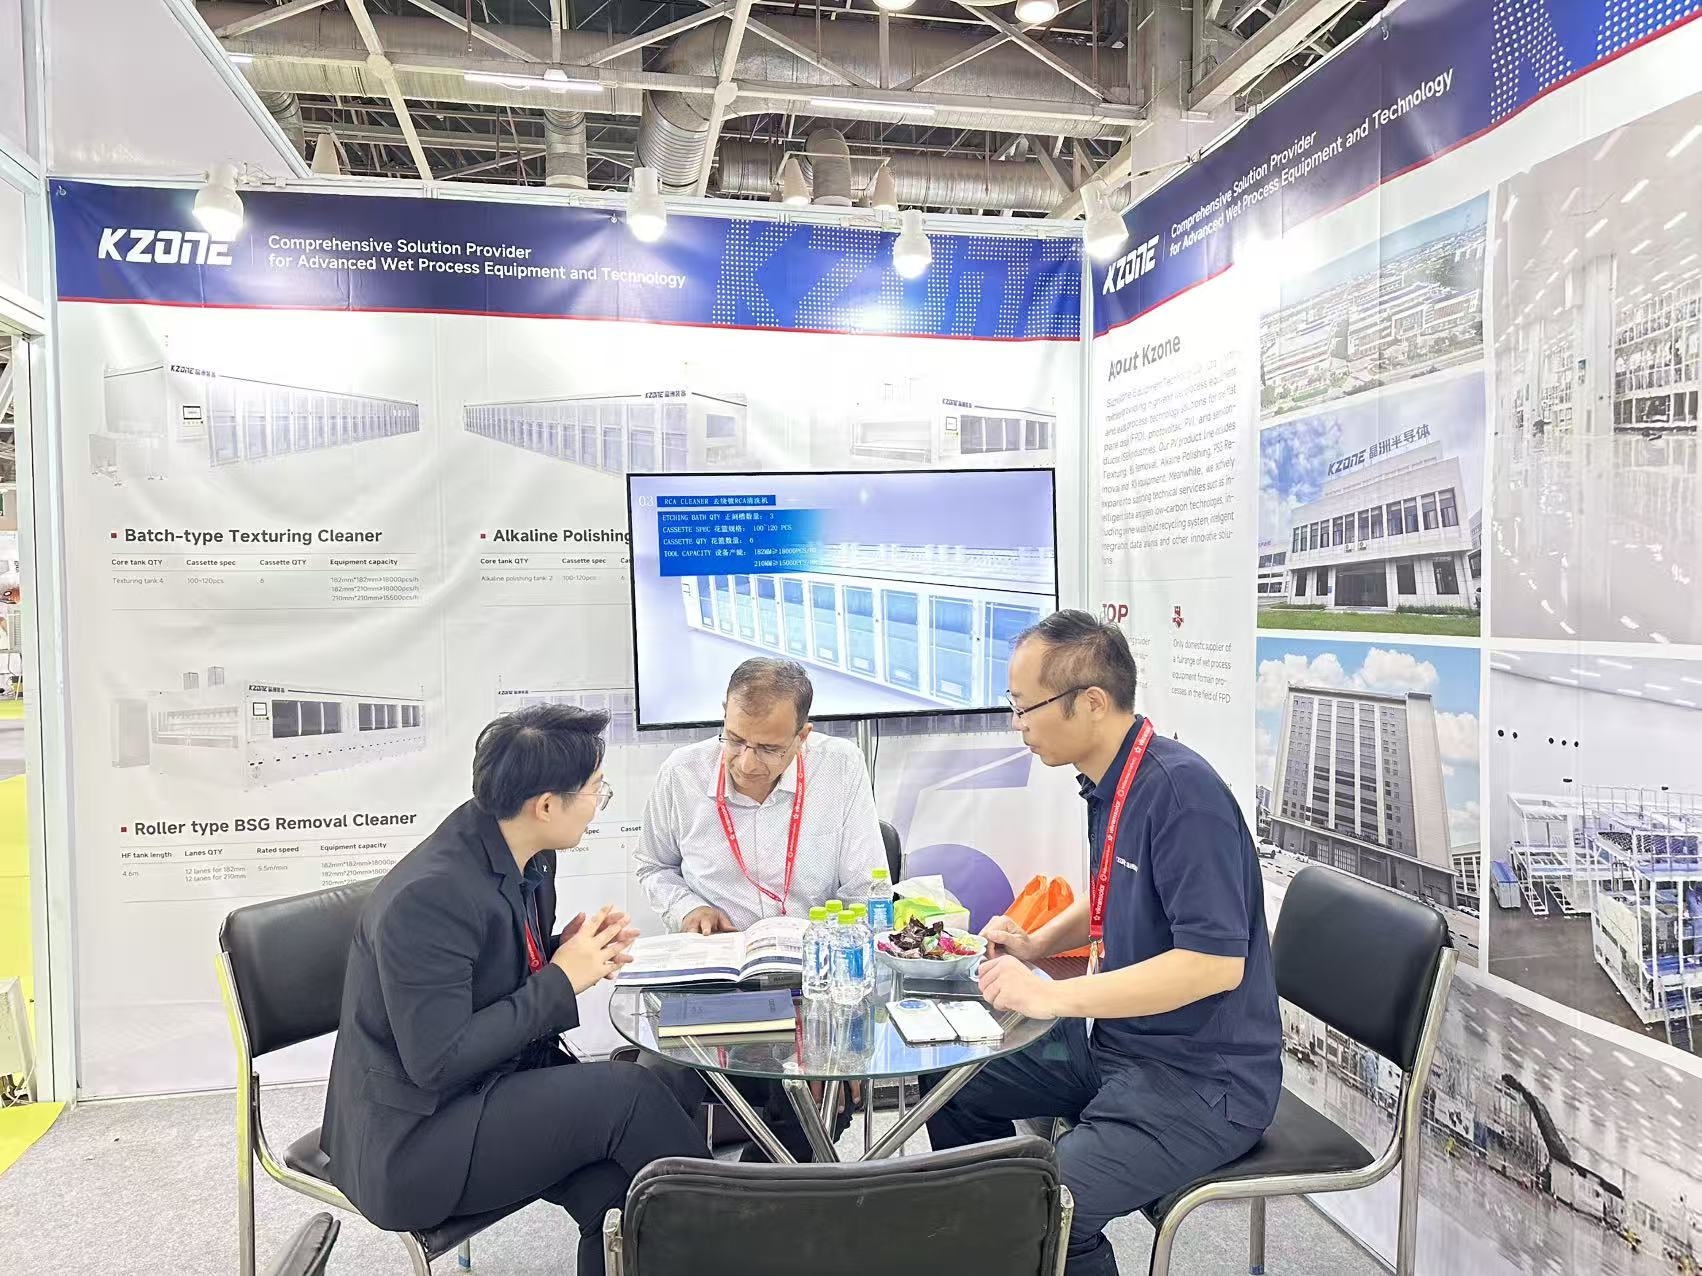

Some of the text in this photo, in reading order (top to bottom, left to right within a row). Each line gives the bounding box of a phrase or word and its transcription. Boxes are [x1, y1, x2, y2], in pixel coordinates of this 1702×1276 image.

[1170, 68, 1453, 257] for Advanced Wet Process Equipment and Technology
[1171, 131, 1316, 238] Comprehensive Solution Provider
[98, 228, 233, 266] KZONE
[268, 235, 531, 259] Comprehensive Solution Provider
[1102, 234, 1159, 295] KZONE
[268, 255, 687, 289] for Advanced Wet Process Equipment and Technology
[1142, 335, 1181, 367] Kzone
[1369, 424, 1431, 460] 晶洲半导体
[1328, 448, 1366, 476] KZONE
[493, 528, 630, 544] Alkaline Polishing
[662, 526, 693, 534] CASSETTE
[125, 528, 383, 546] Batch-type Texturing Cleaner
[664, 550, 680, 558] TOOL
[147, 559, 162, 567] QTY
[220, 560, 236, 568] spec
[330, 558, 366, 567] Equipment
[592, 558, 607, 566] spec
[135, 813, 417, 836] Roller type BSG Removal Cleaner
[208, 848, 223, 856] QTY
[278, 846, 299, 854] speed
[320, 842, 387, 851] Equipment capacity
[150, 851, 172, 860] length
[212, 866, 222, 874] for
[194, 874, 212, 882] lanes
